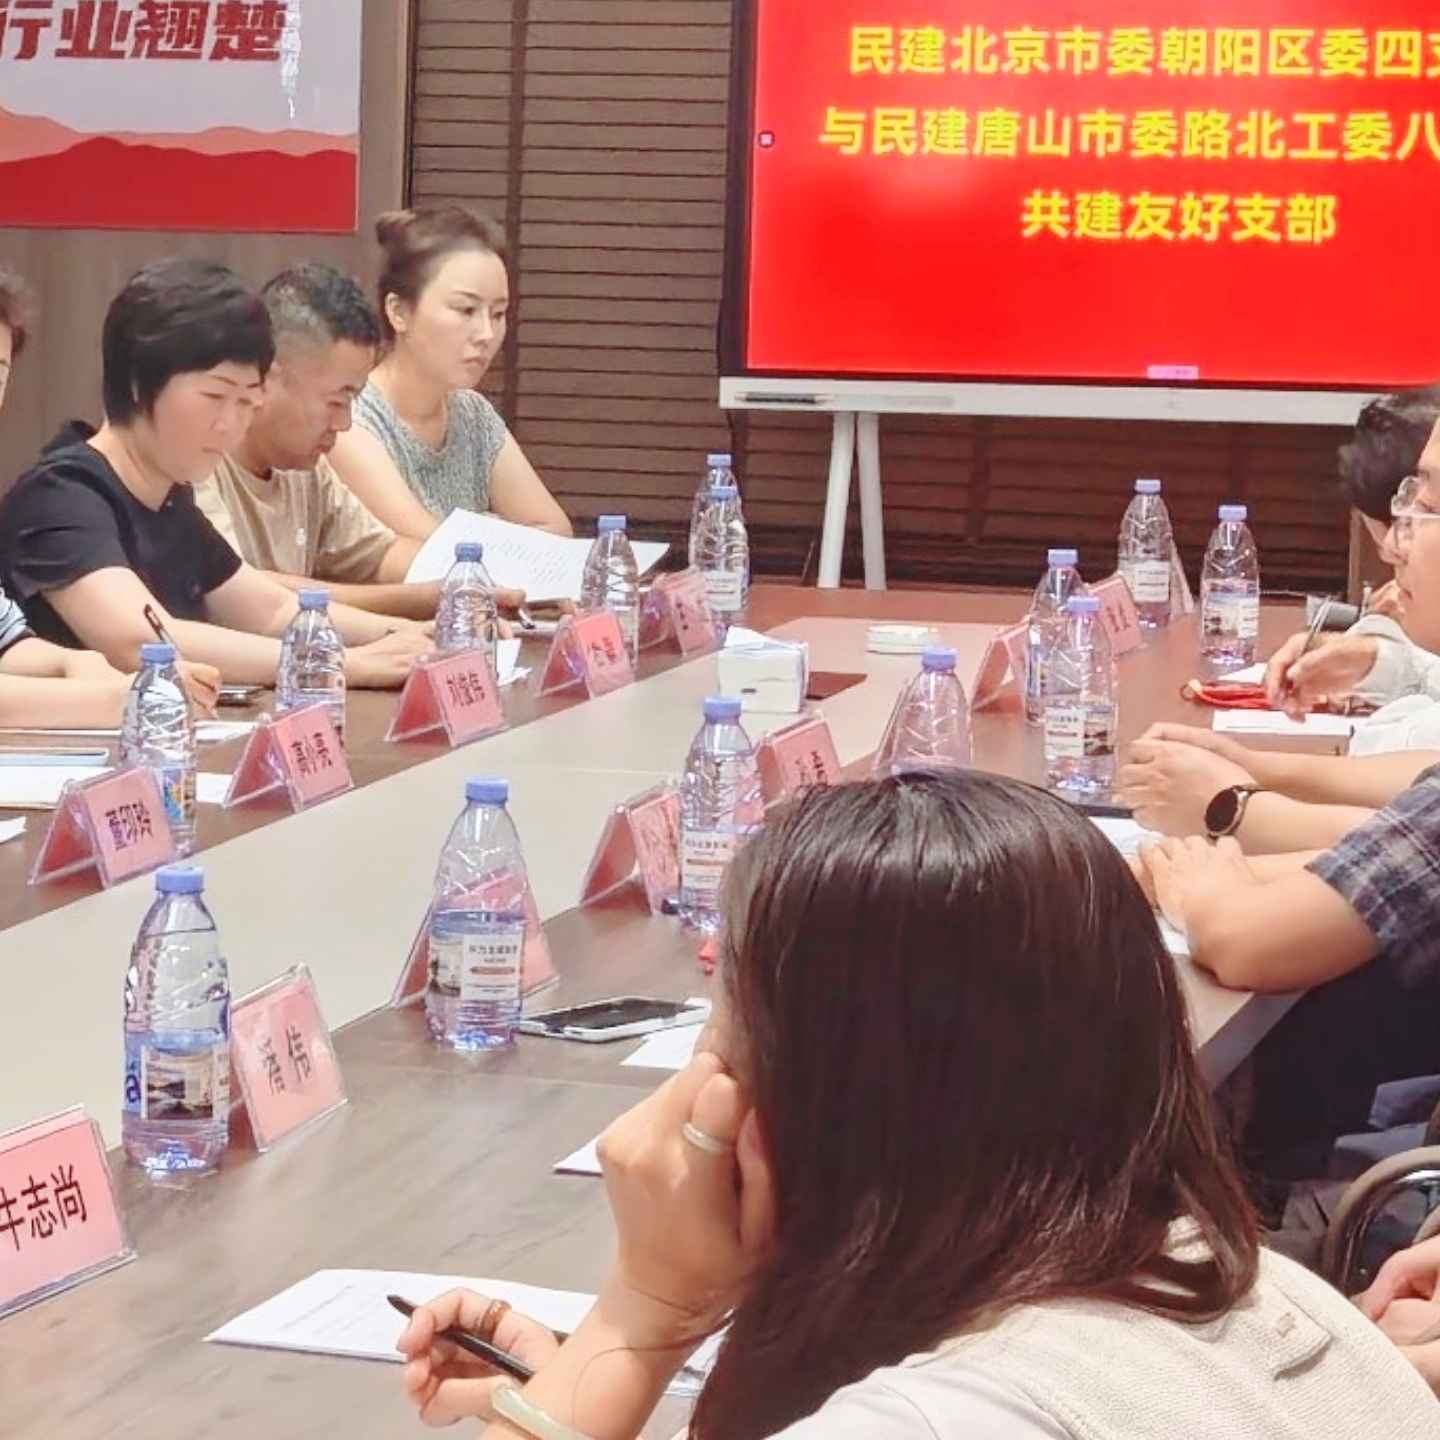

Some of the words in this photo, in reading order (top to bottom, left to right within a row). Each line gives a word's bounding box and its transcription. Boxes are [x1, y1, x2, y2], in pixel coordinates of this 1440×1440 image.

[1022, 190, 1338, 244] 共建友好支部
